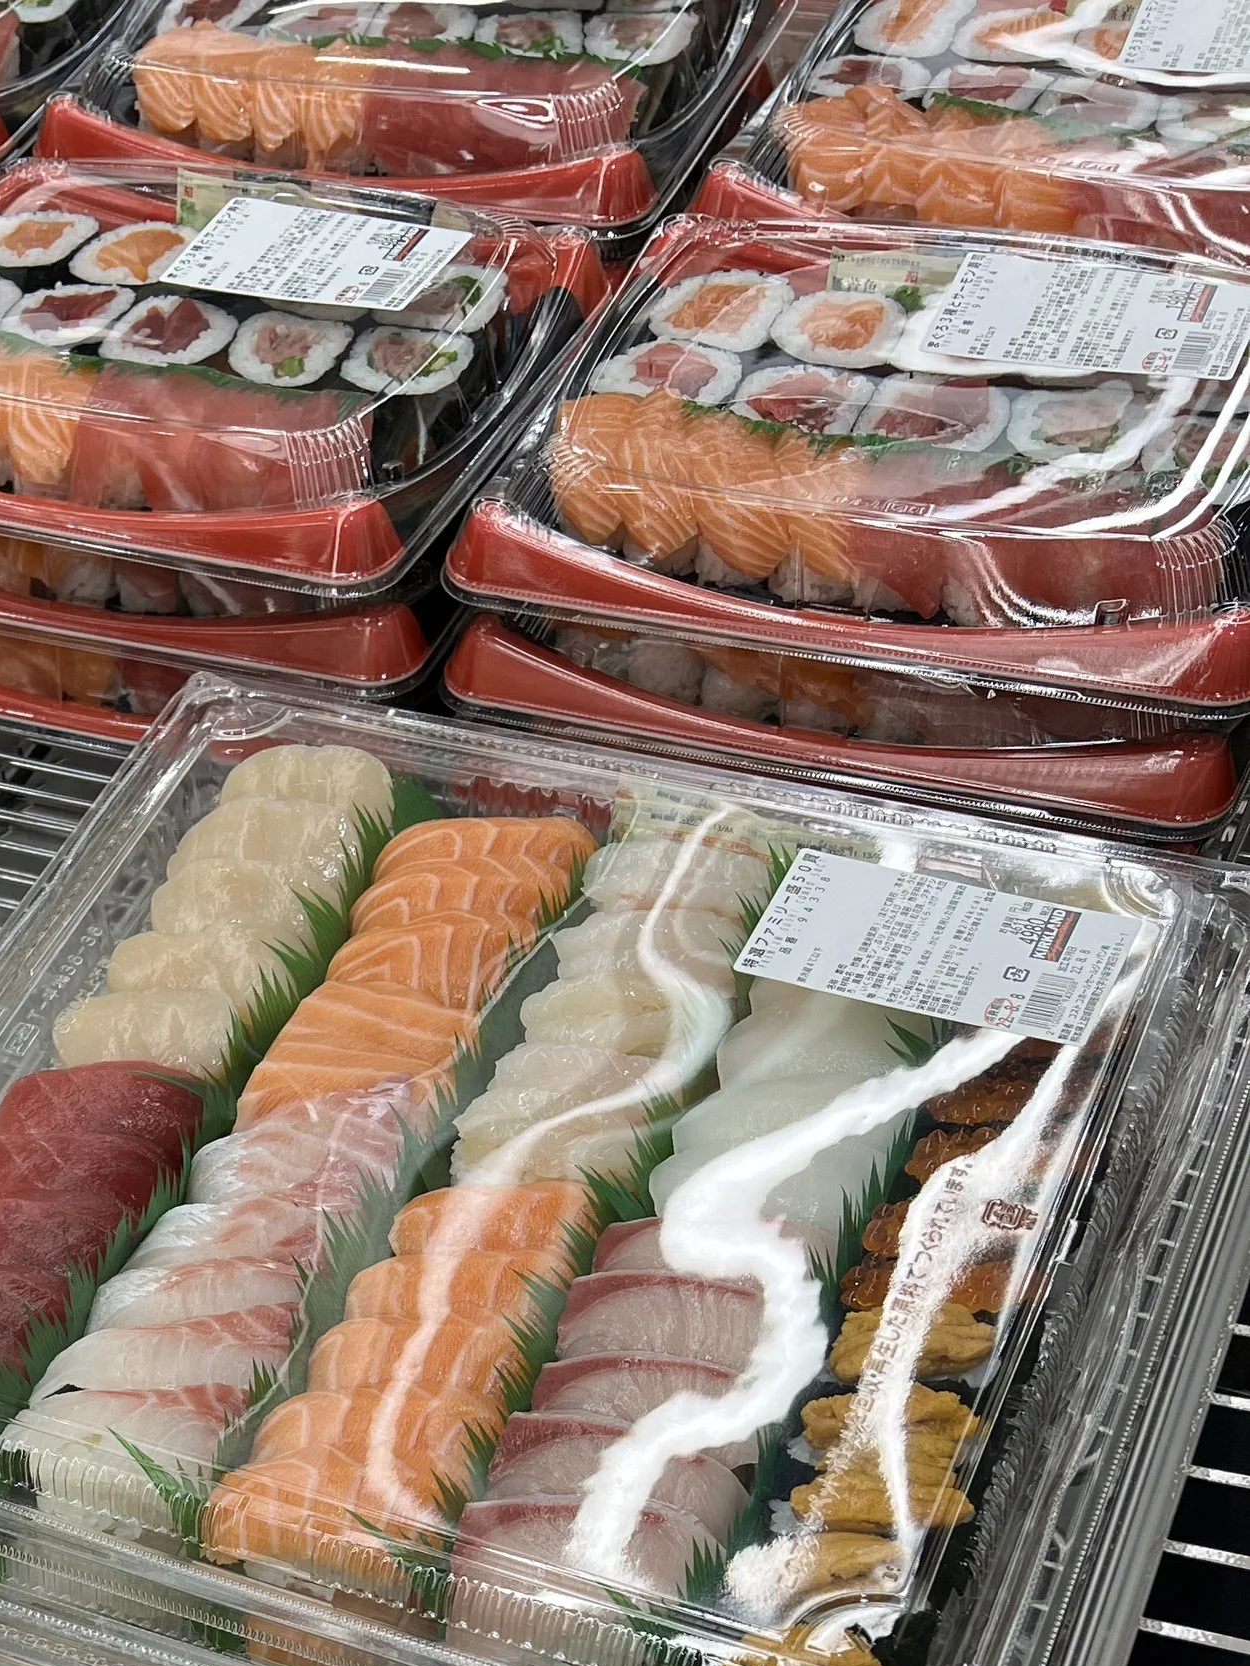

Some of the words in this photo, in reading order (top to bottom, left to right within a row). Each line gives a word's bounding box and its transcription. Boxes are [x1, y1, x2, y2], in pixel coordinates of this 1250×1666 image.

[926, 253, 986, 348] まぐろ3種とサーモン寿司
[741, 852, 820, 969] 特選ファミリー盛50貫
[1016, 916, 1047, 945] 4980
[1031, 908, 1068, 958] KIRKLAND
[1004, 1002, 1021, 1011] 8.
[1009, 992, 1025, 1000] 8
[996, 1014, 1014, 1028] 22.
